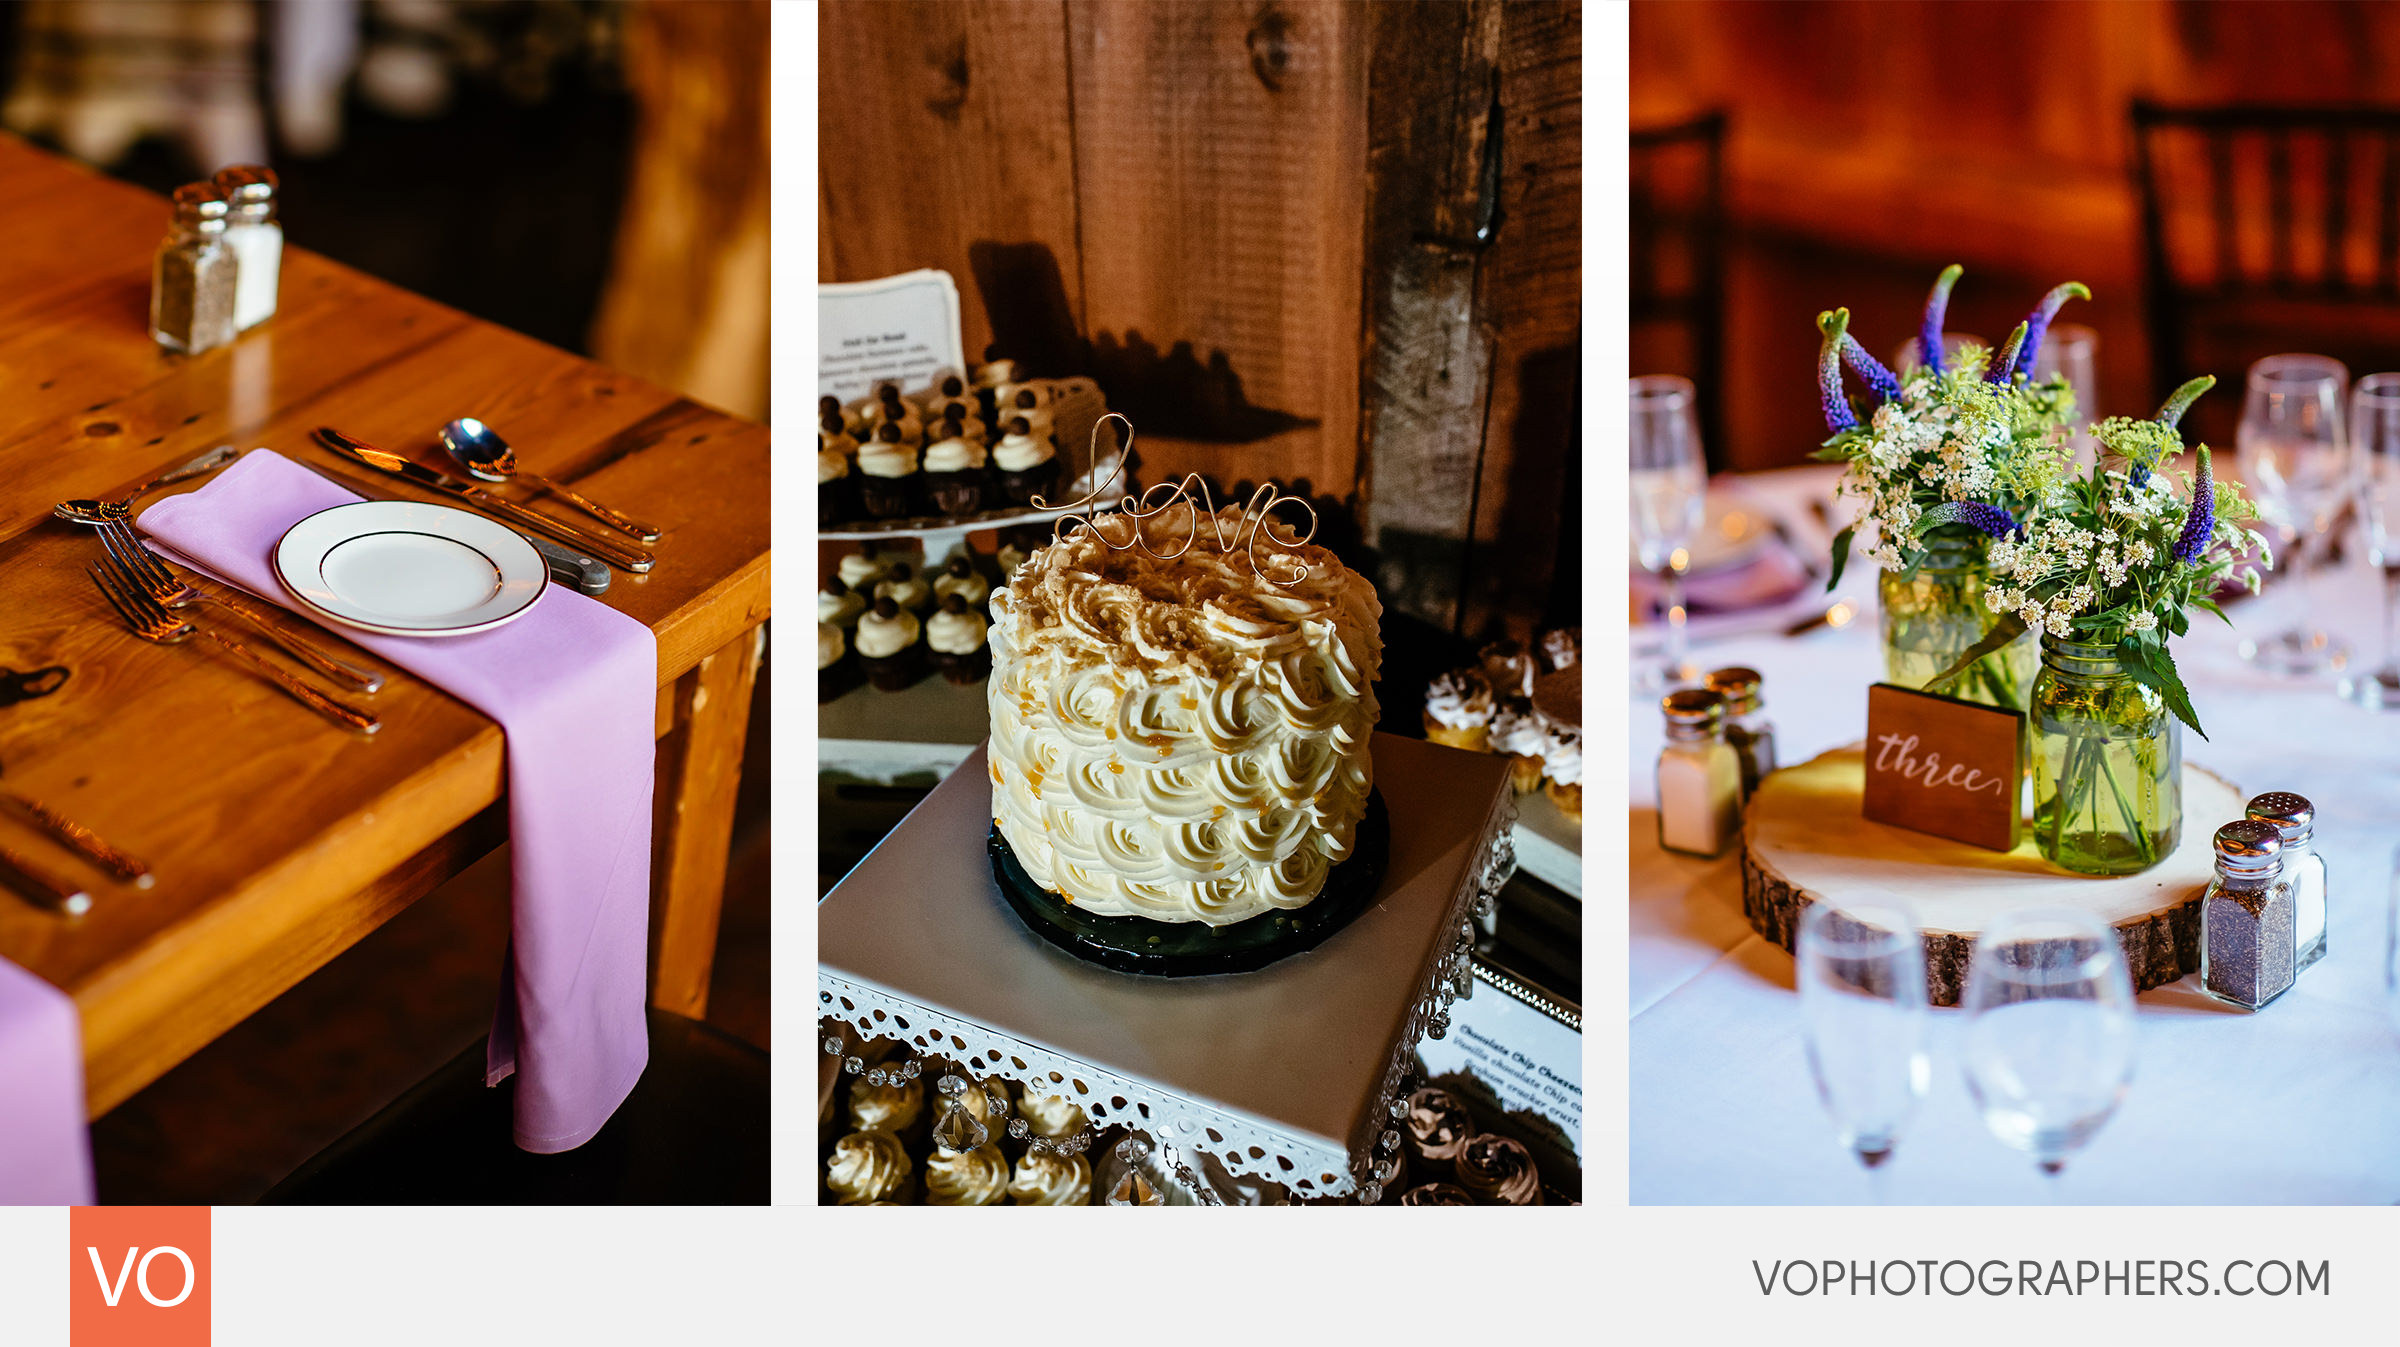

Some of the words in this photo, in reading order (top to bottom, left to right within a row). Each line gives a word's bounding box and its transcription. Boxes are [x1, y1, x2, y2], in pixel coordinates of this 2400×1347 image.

[1875, 732, 2004, 796] three
[1452, 1036, 1489, 1061] Vanilla
[1490, 1059, 1541, 1089] chocolate
[1543, 1084, 1568, 1104] Chip
[1459, 1023, 1510, 1056] Chocolate
[1511, 1051, 1536, 1070] Chip
[1538, 1065, 1582, 1095] Cheesec
[1506, 1084, 1547, 1108] cracker
[1548, 1106, 1580, 1129] crust.
